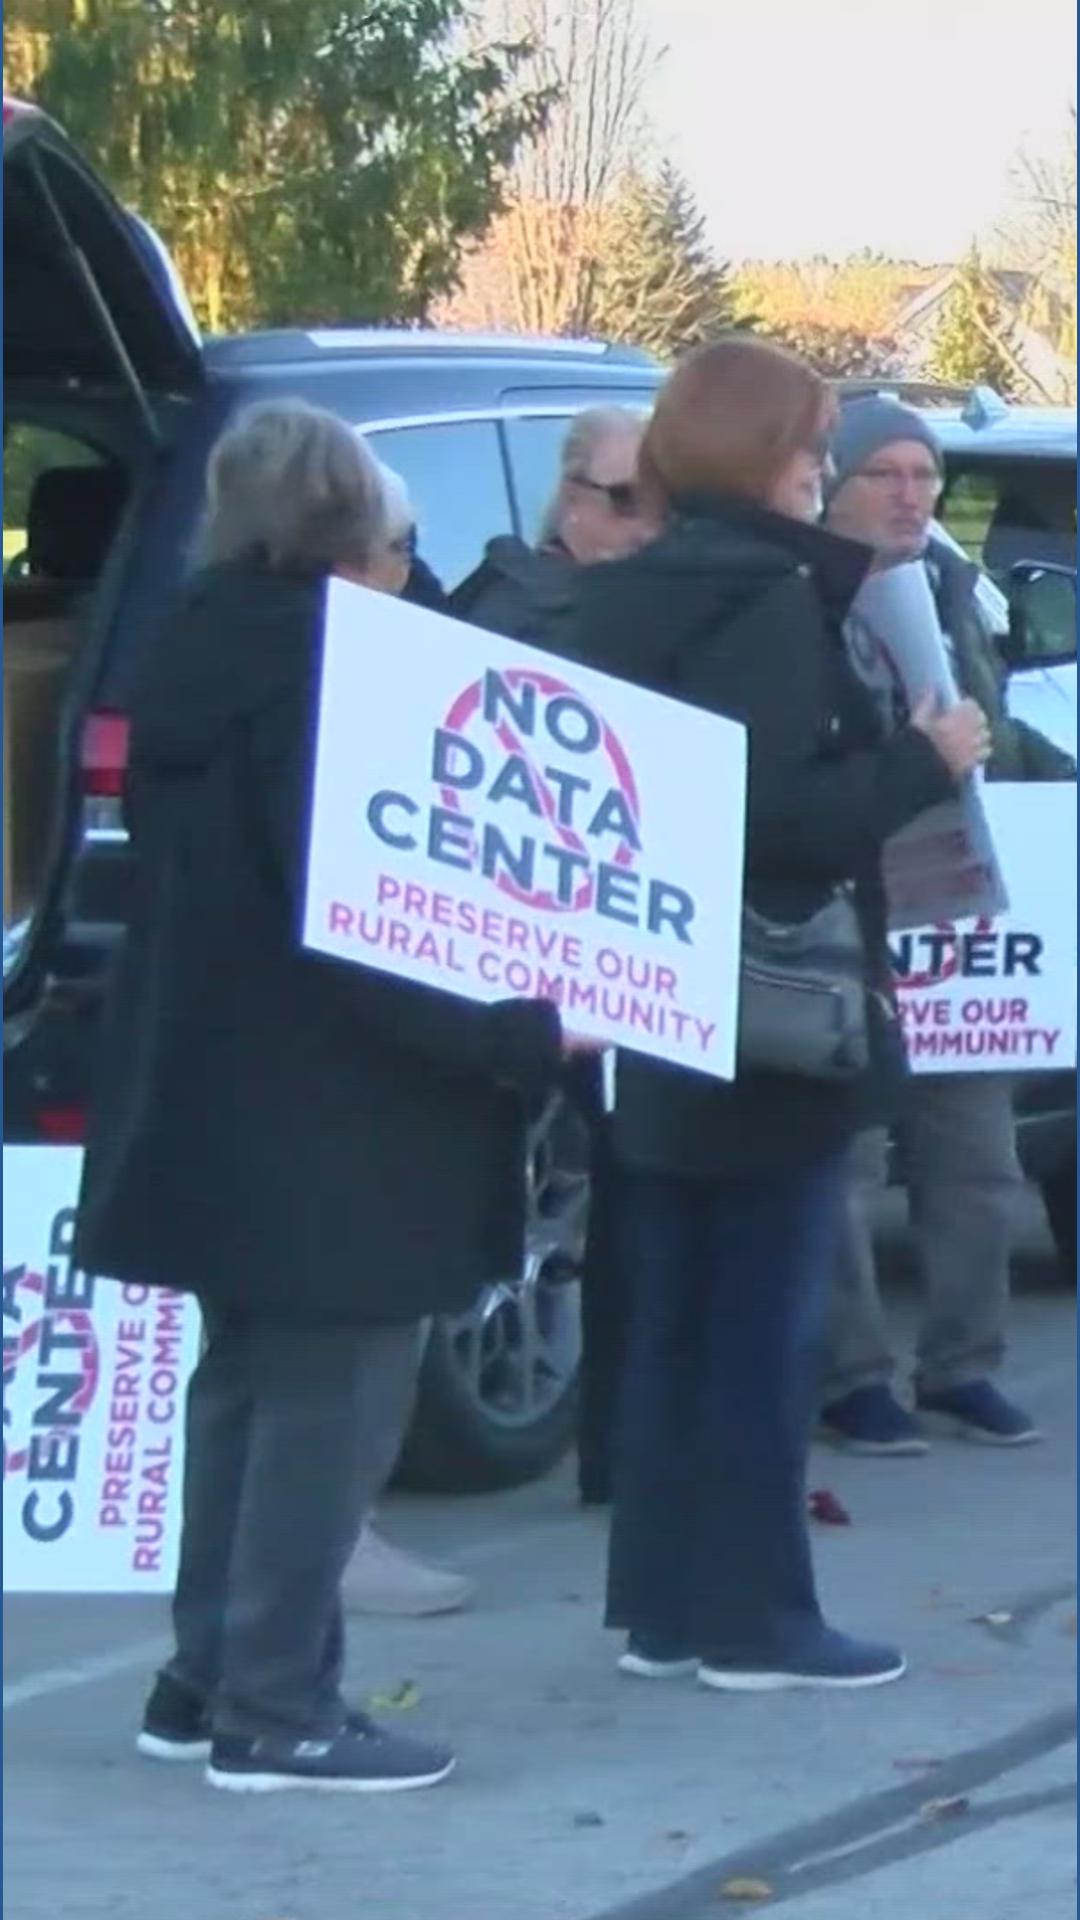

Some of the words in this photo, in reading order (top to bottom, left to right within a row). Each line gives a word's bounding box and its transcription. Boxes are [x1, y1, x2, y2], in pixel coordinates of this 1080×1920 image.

[482, 667, 600, 754] NO
[432, 728, 642, 851] DATA
[367, 790, 696, 946] CENTER
[329, 902, 464, 973] RURAL
[478, 952, 717, 1051] COMMUNITY
[377, 874, 583, 968] PRESERVE
[597, 949, 678, 999] OUR
[890, 933, 1044, 976] NTER
[905, 1029, 1061, 1056] MMUNITY
[961, 998, 1028, 1024] OUR
[99, 1320, 146, 1526] PRESERVE
[132, 1437, 172, 1572] RURAL
